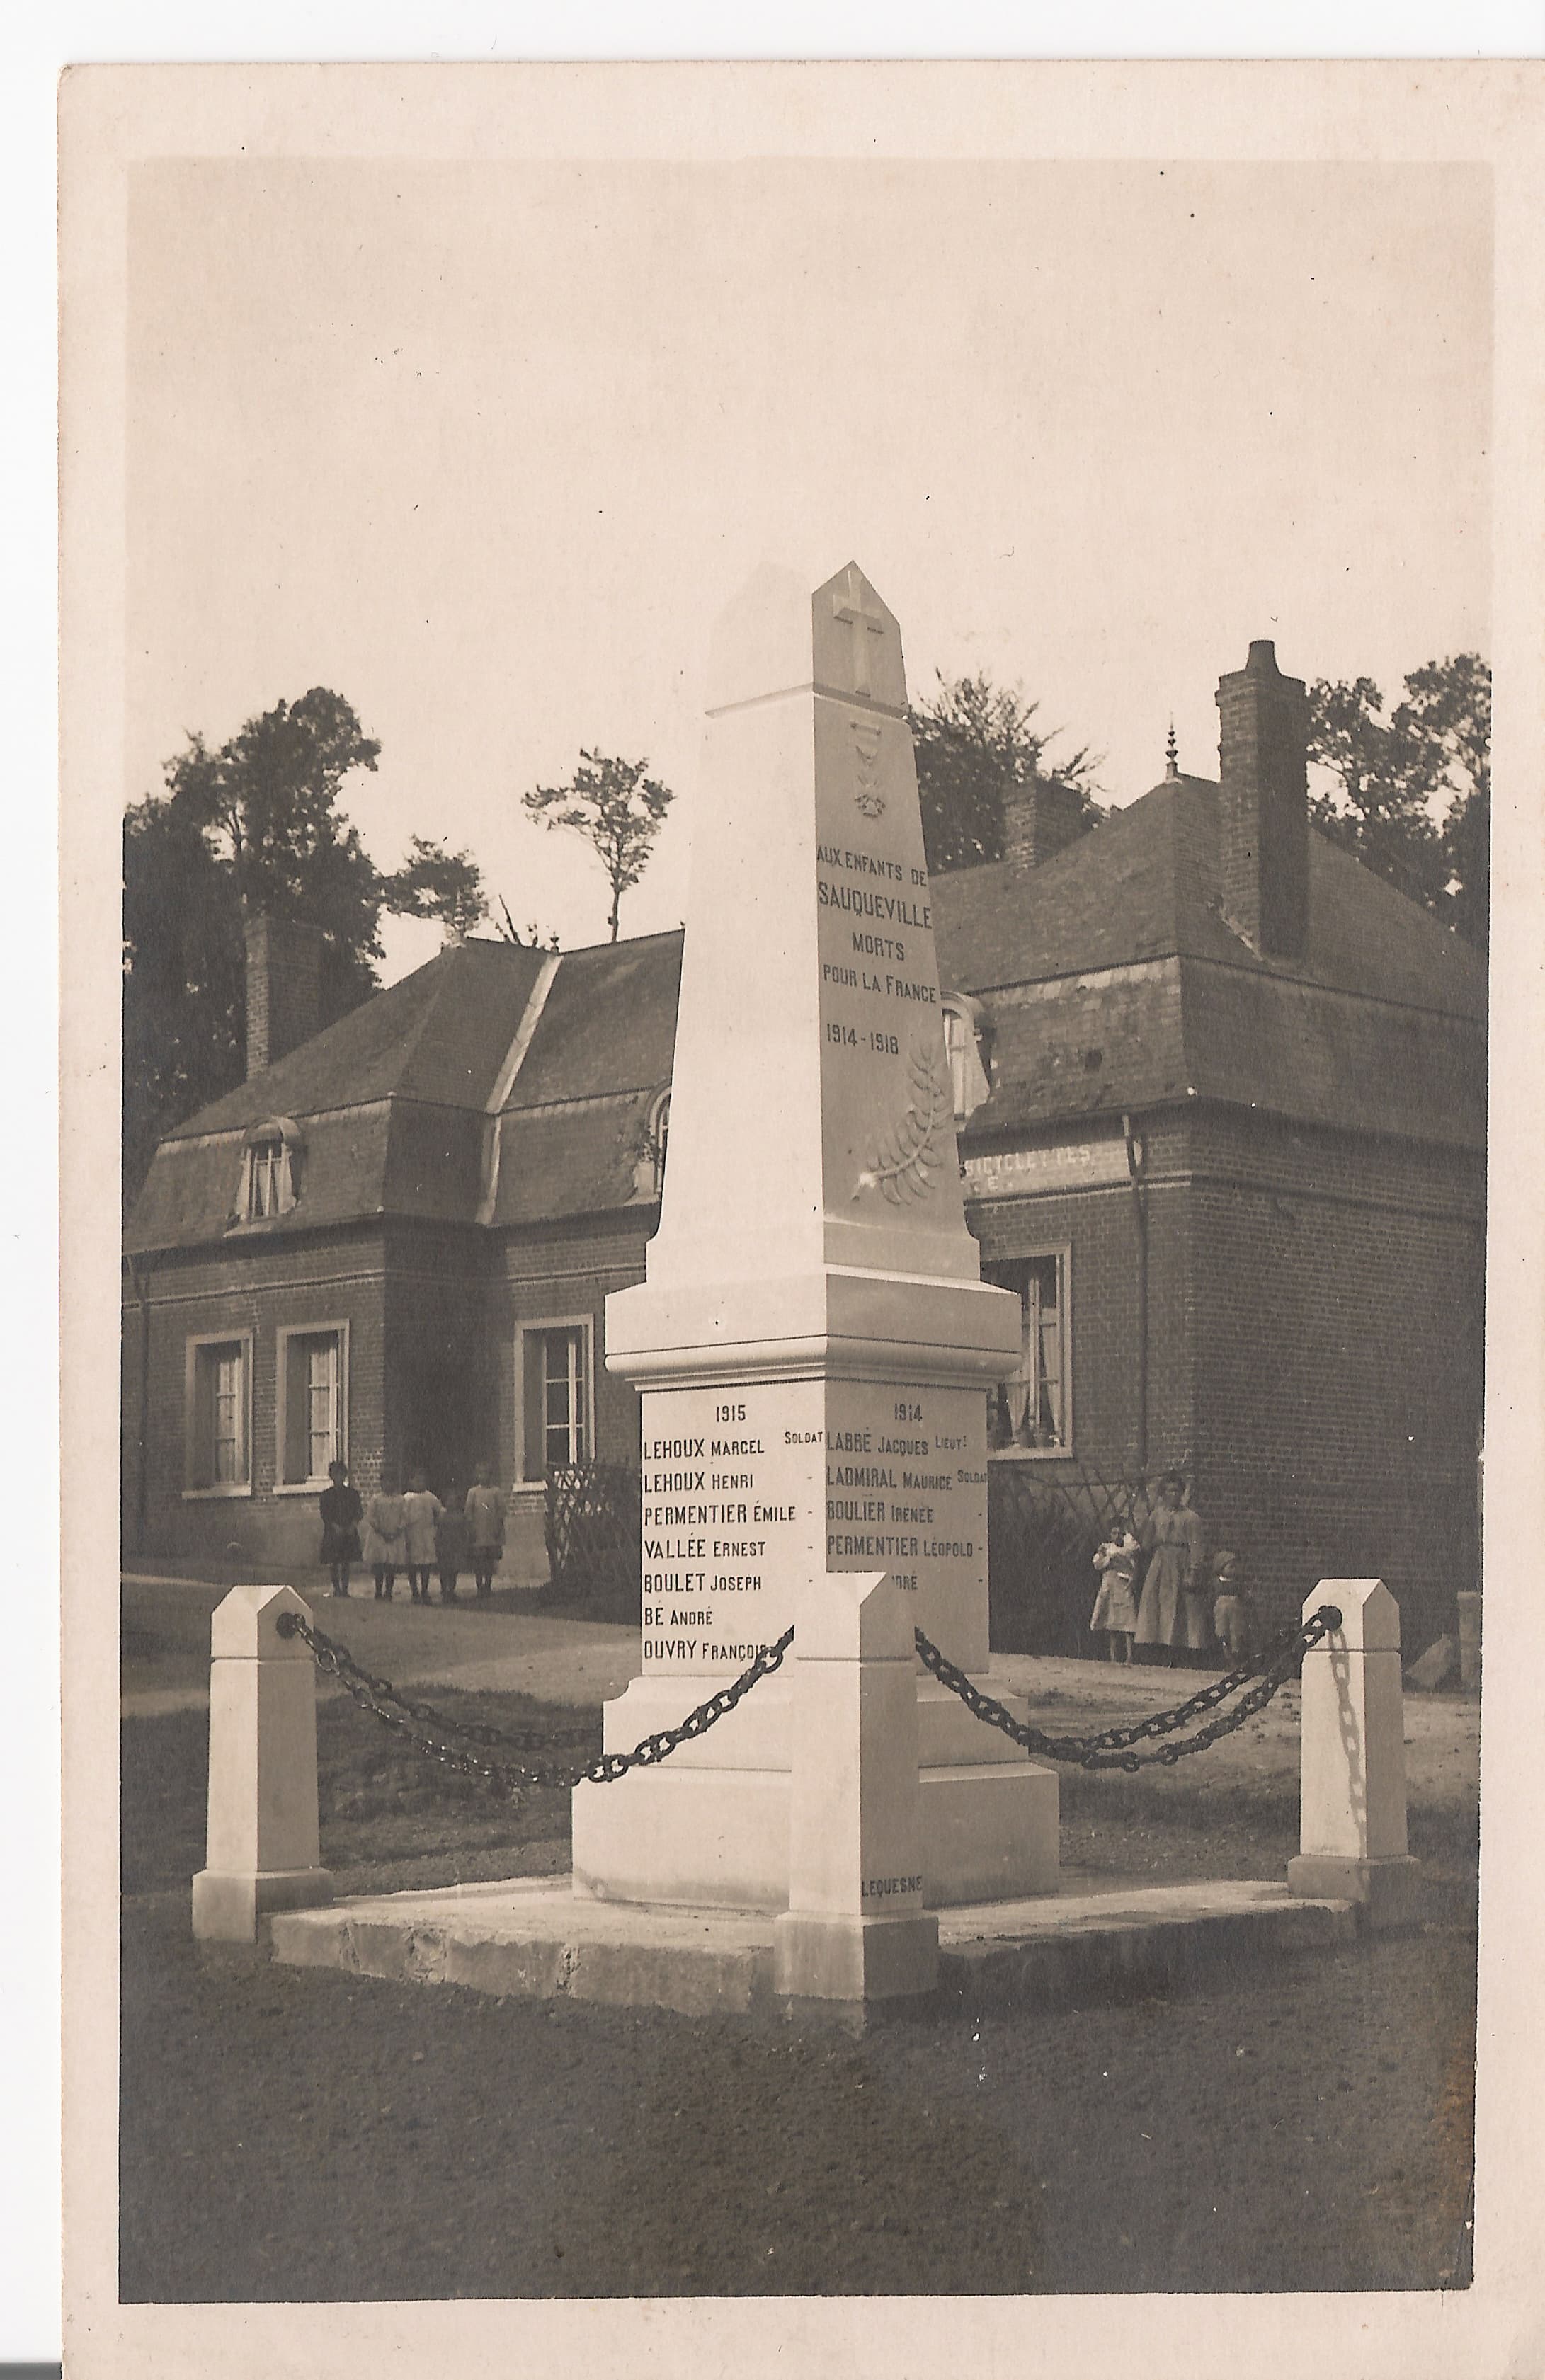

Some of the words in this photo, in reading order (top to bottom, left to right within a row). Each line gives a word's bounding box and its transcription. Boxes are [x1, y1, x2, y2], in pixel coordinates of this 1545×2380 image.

[816, 845, 842, 866] AUX
[845, 852, 903, 881] ENFANTS
[911, 868, 927, 886] DE
[819, 881, 933, 929] SAUQUEVILLE
[853, 932, 905, 961] MORTS
[823, 964, 857, 988] POUR
[862, 972, 882, 992] LA
[886, 975, 937, 1004] FRANCE
[717, 1404, 746, 1423] 1915
[894, 1403, 923, 1422] 1914
[644, 1438, 705, 1460] LEHOUX
[711, 1440, 765, 1457] MARCEL
[785, 1431, 823, 1444] SOLDAT
[878, 1436, 929, 1456] JACQUES
[644, 1472, 705, 1493] LEHOUX
[712, 1474, 753, 1489] HENRI
[827, 1465, 897, 1488] LADMIRAL
[903, 1472, 952, 1491] MAURICE
[644, 1504, 747, 1526] PERMENTIER
[753, 1501, 796, 1522] ÉMILE
[827, 1500, 886, 1521] BOULIER
[644, 1532, 706, 1558] VALLÉE
[714, 1540, 766, 1557] ERNEST
[827, 1535, 918, 1557] PERMENTIER
[923, 1537, 974, 1557] LÉOPOLD
[644, 1573, 705, 1593] BOULET
[710, 1575, 762, 1591] JOSEPH
[671, 1606, 713, 1625] ANDRÉ
[644, 1640, 697, 1659] OUVRY
[861, 1875, 922, 1898] LEQUESNE
